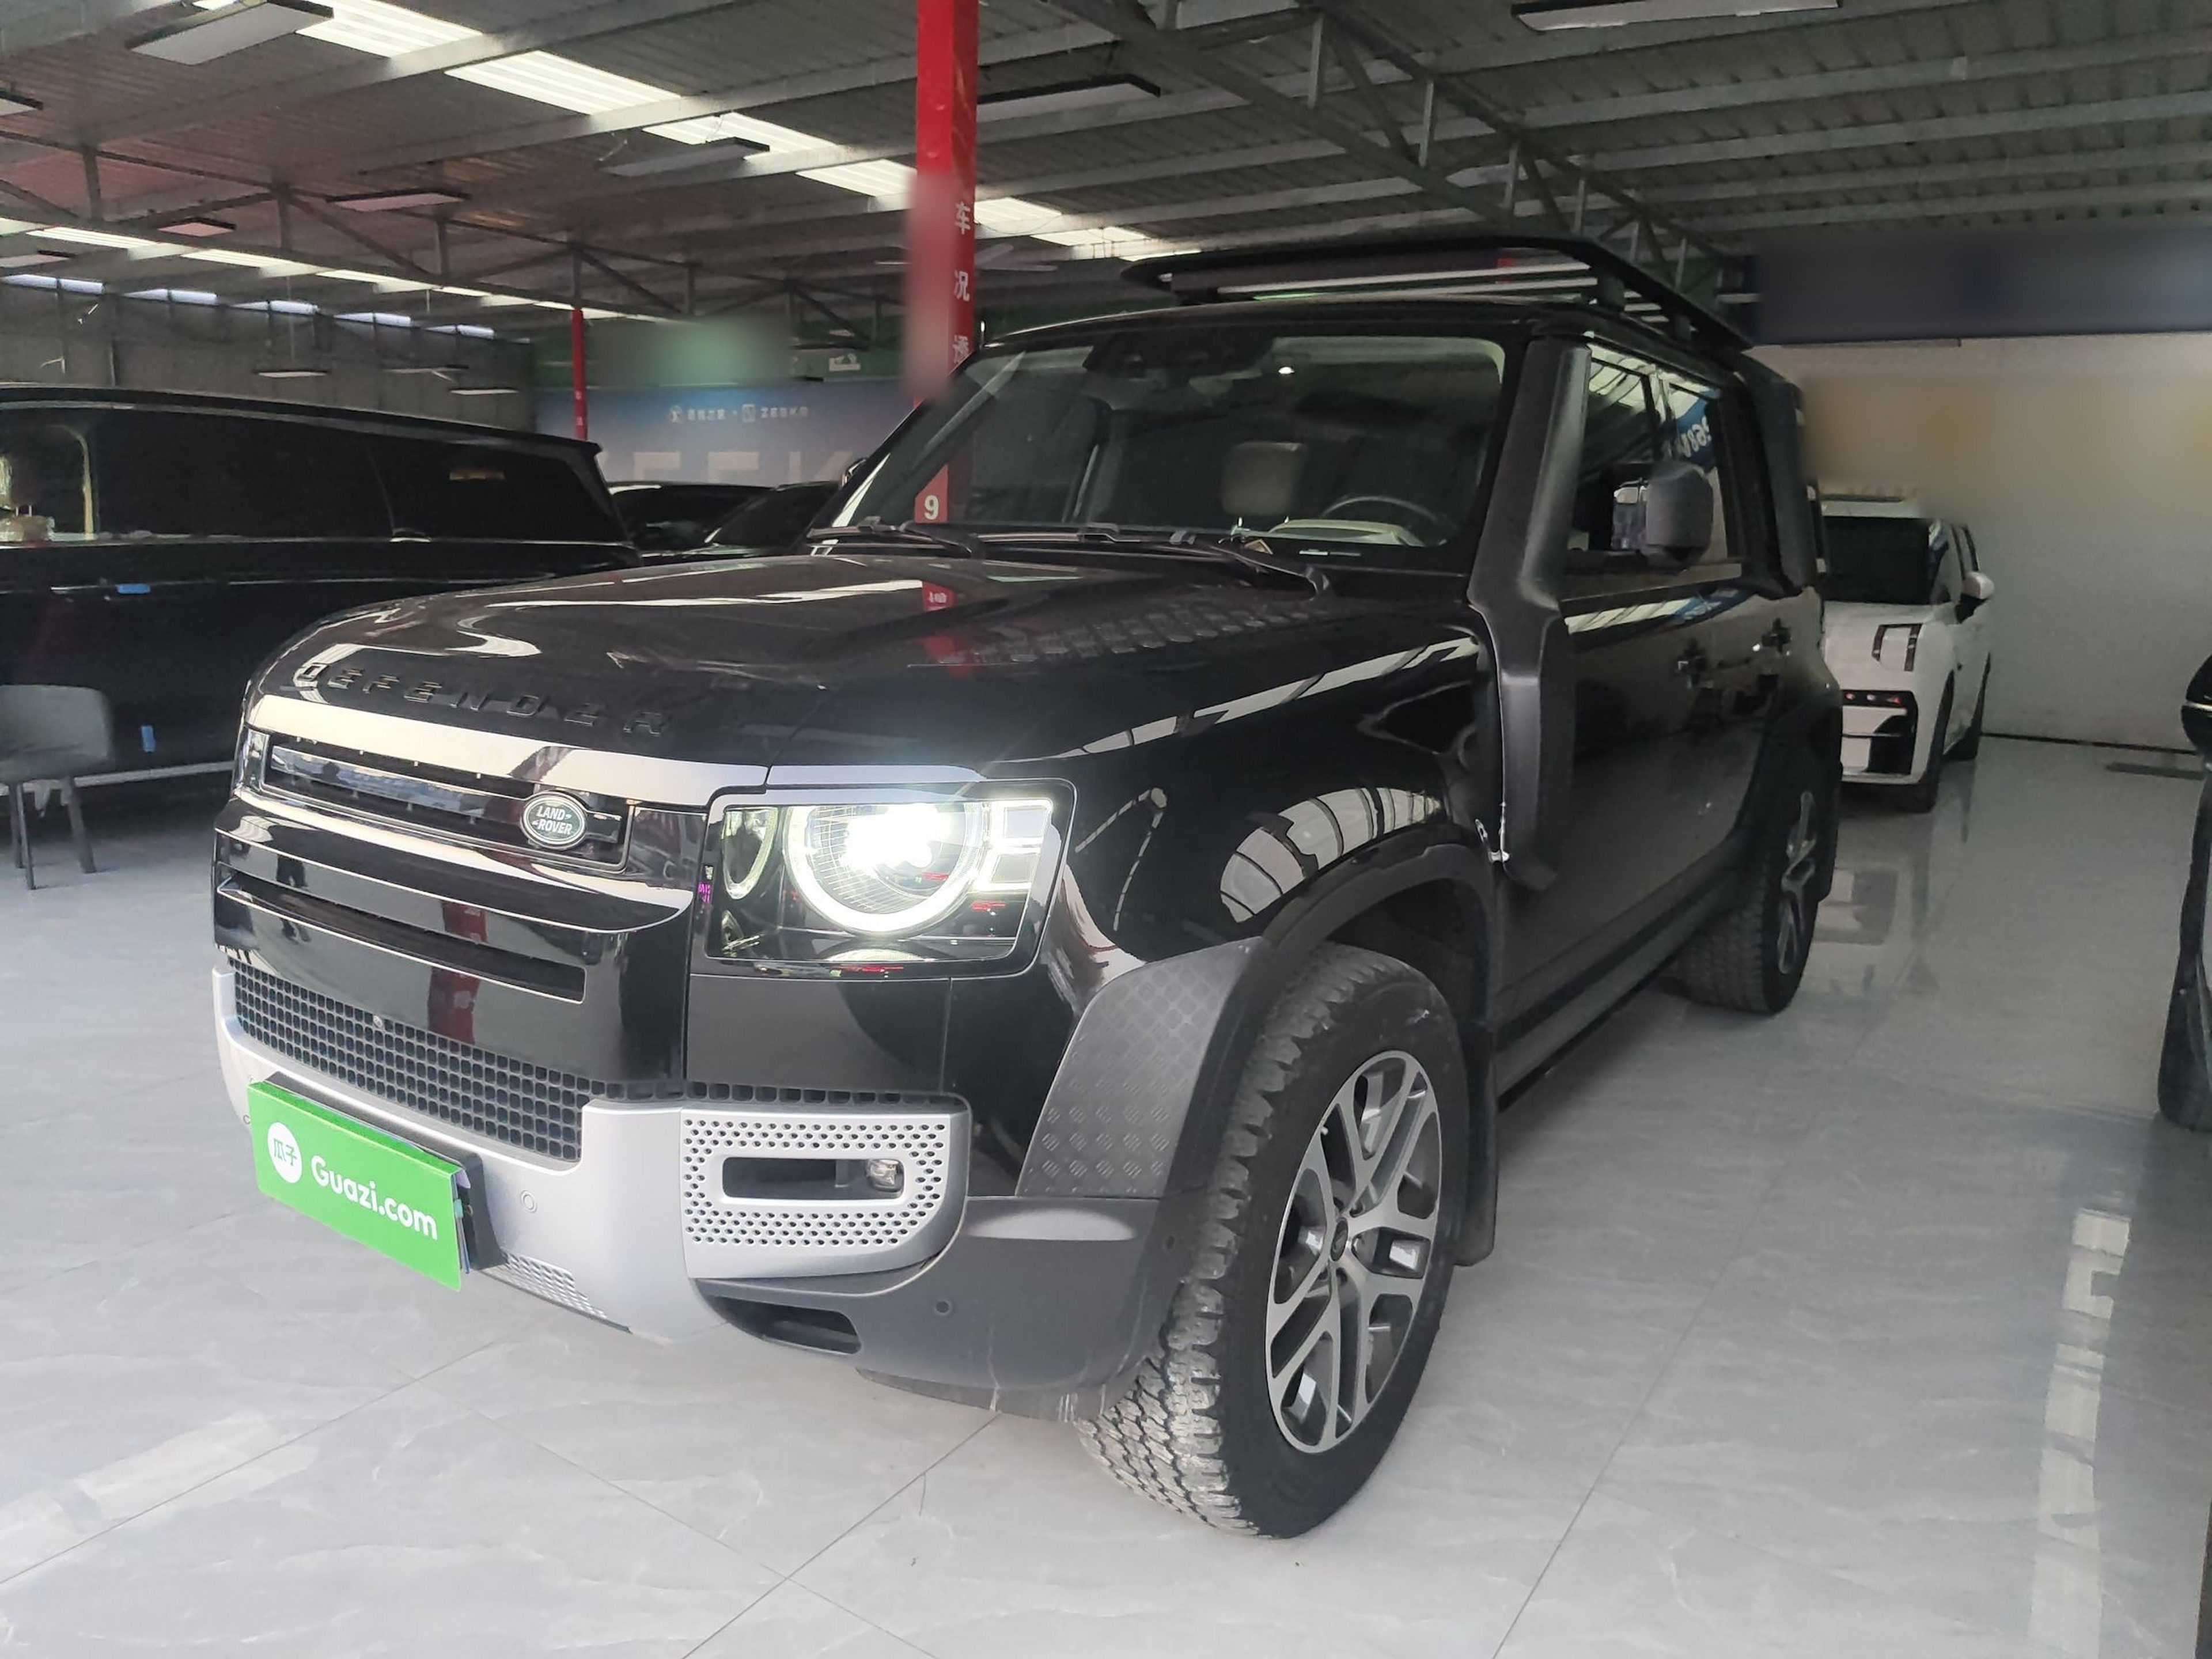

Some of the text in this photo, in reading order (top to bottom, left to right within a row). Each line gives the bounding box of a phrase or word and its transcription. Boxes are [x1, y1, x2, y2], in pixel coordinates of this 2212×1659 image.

[923, 495, 940, 520] 9
[272, 1138, 438, 1241] 瓜子 Guazi.com
